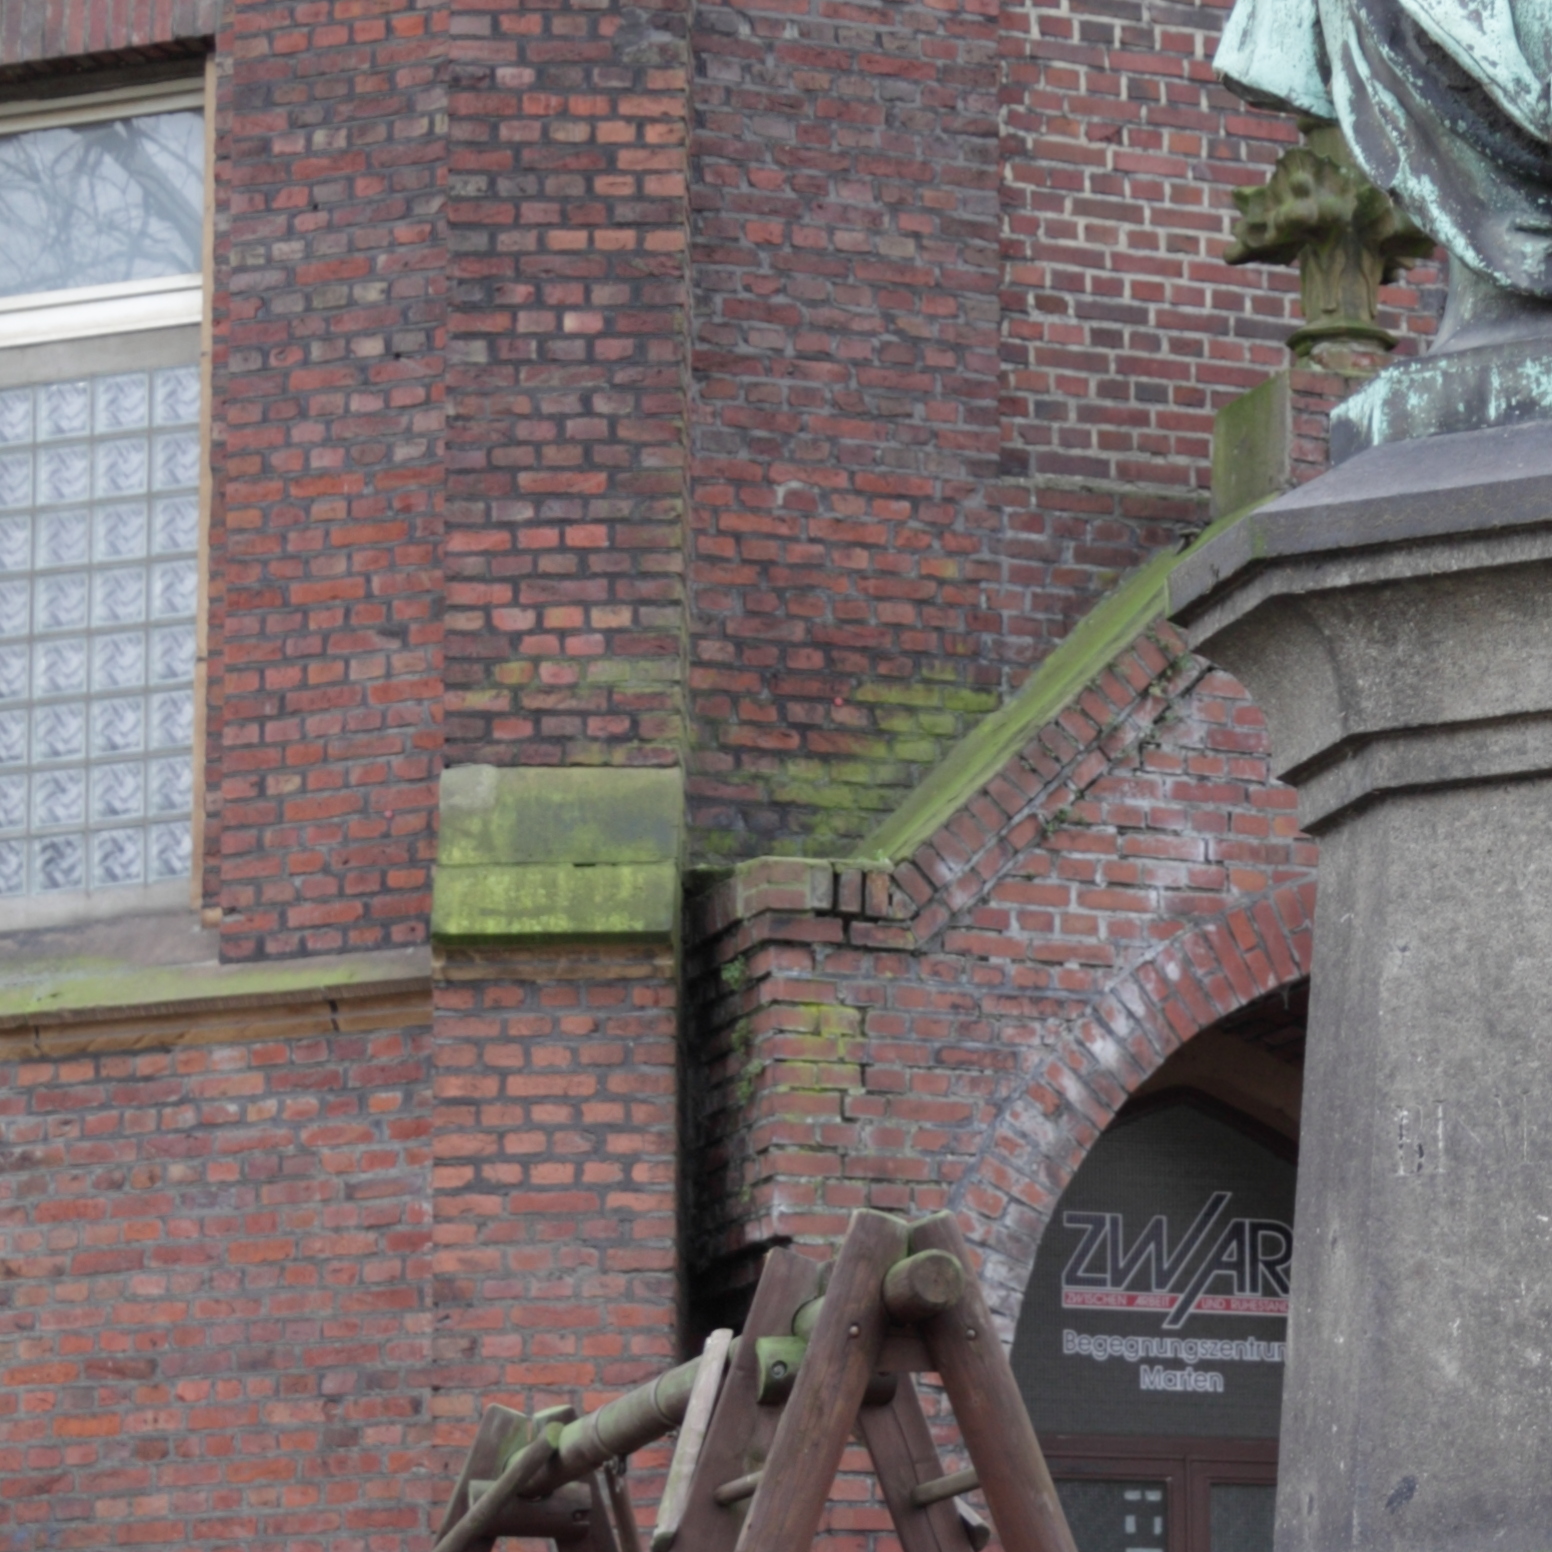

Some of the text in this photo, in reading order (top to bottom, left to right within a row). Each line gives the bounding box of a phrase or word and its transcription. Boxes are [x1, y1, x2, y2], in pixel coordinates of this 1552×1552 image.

[1062, 1191, 1294, 1329] ZWAR
[1065, 1291, 1128, 1306] ZWISCHEN
[1133, 1294, 1170, 1308] ARBEIT
[1201, 1297, 1227, 1309] UND
[1139, 1364, 1225, 1392] Marten
